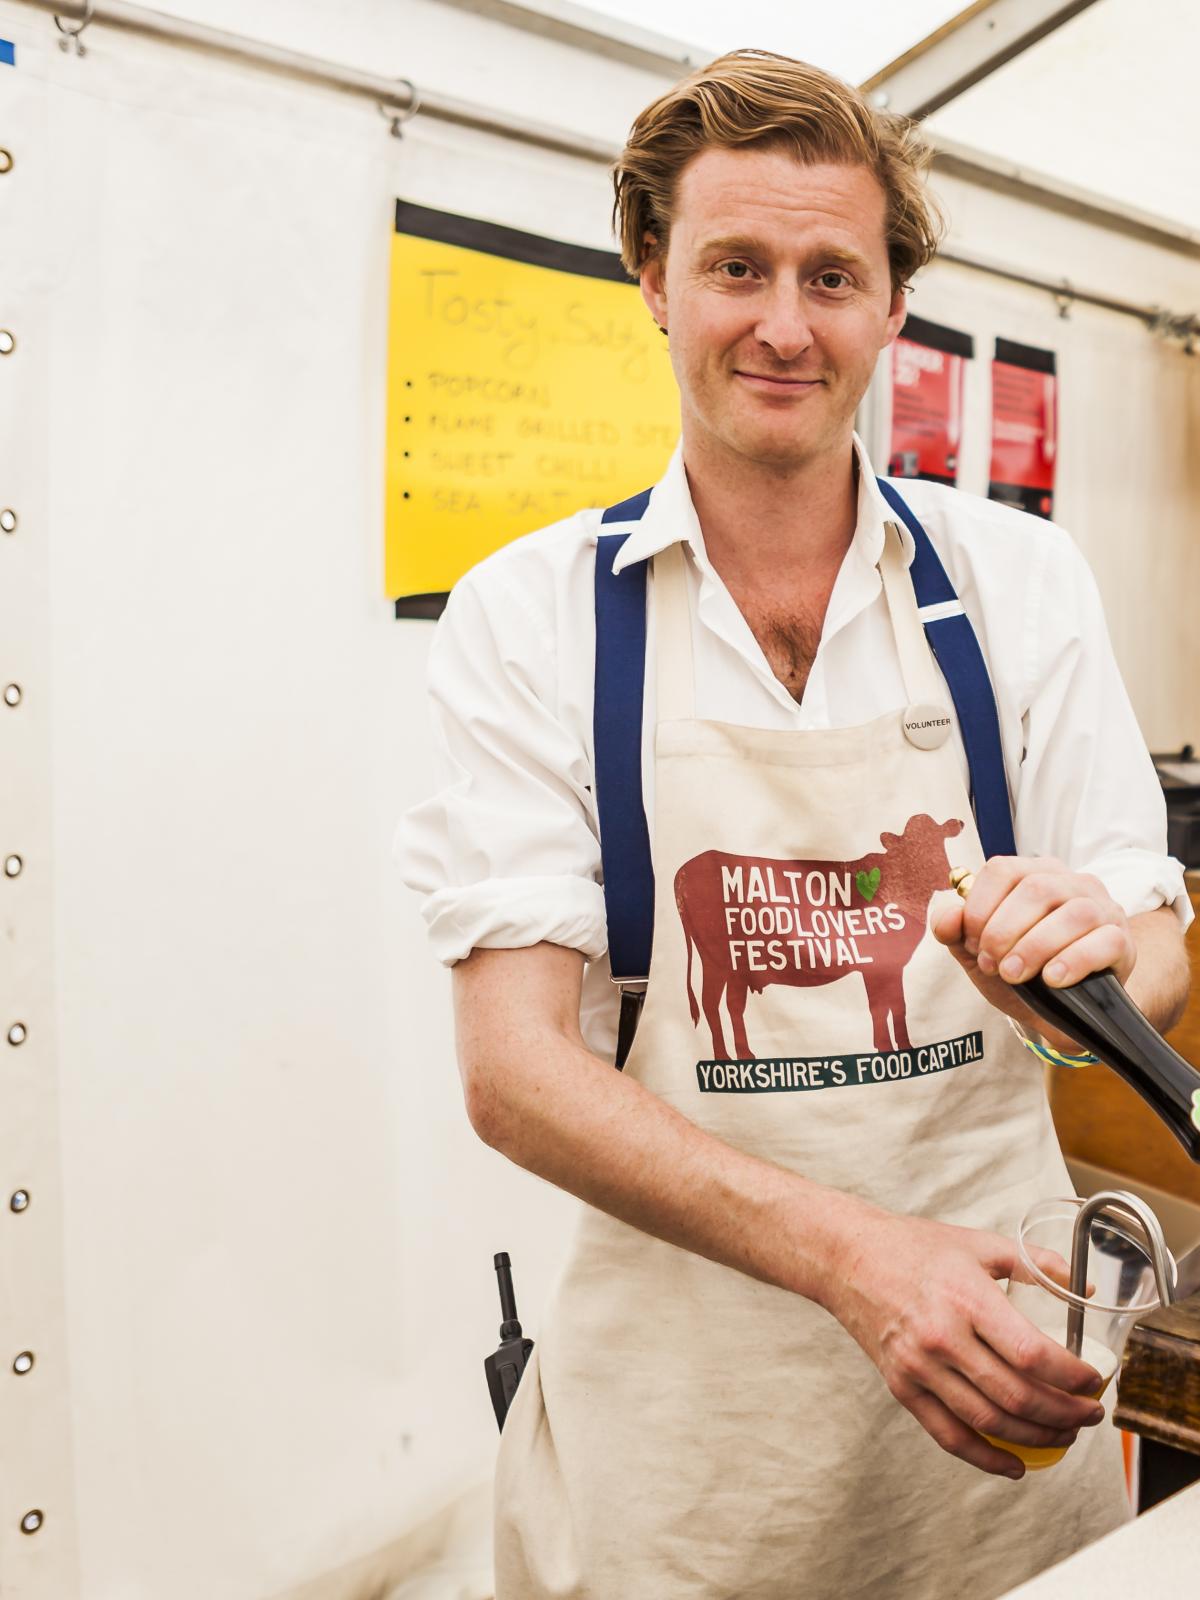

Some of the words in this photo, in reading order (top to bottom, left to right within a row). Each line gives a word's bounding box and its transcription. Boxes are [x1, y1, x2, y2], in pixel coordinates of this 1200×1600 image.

[428, 372, 551, 409] POPCORN
[429, 414, 495, 438] FLAME
[632, 423, 677, 448] STE
[432, 488, 481, 514] SEA
[905, 718, 951, 730] VOLUNTEER
[721, 865, 852, 907] MALTON
[724, 902, 906, 938] FOODLOVERS
[728, 937, 874, 971] FESTIVAL
[699, 1060, 847, 1089] YORKSHIRE'S
[856, 1051, 911, 1082] FOOD
[917, 1035, 982, 1073] CAPITAL
